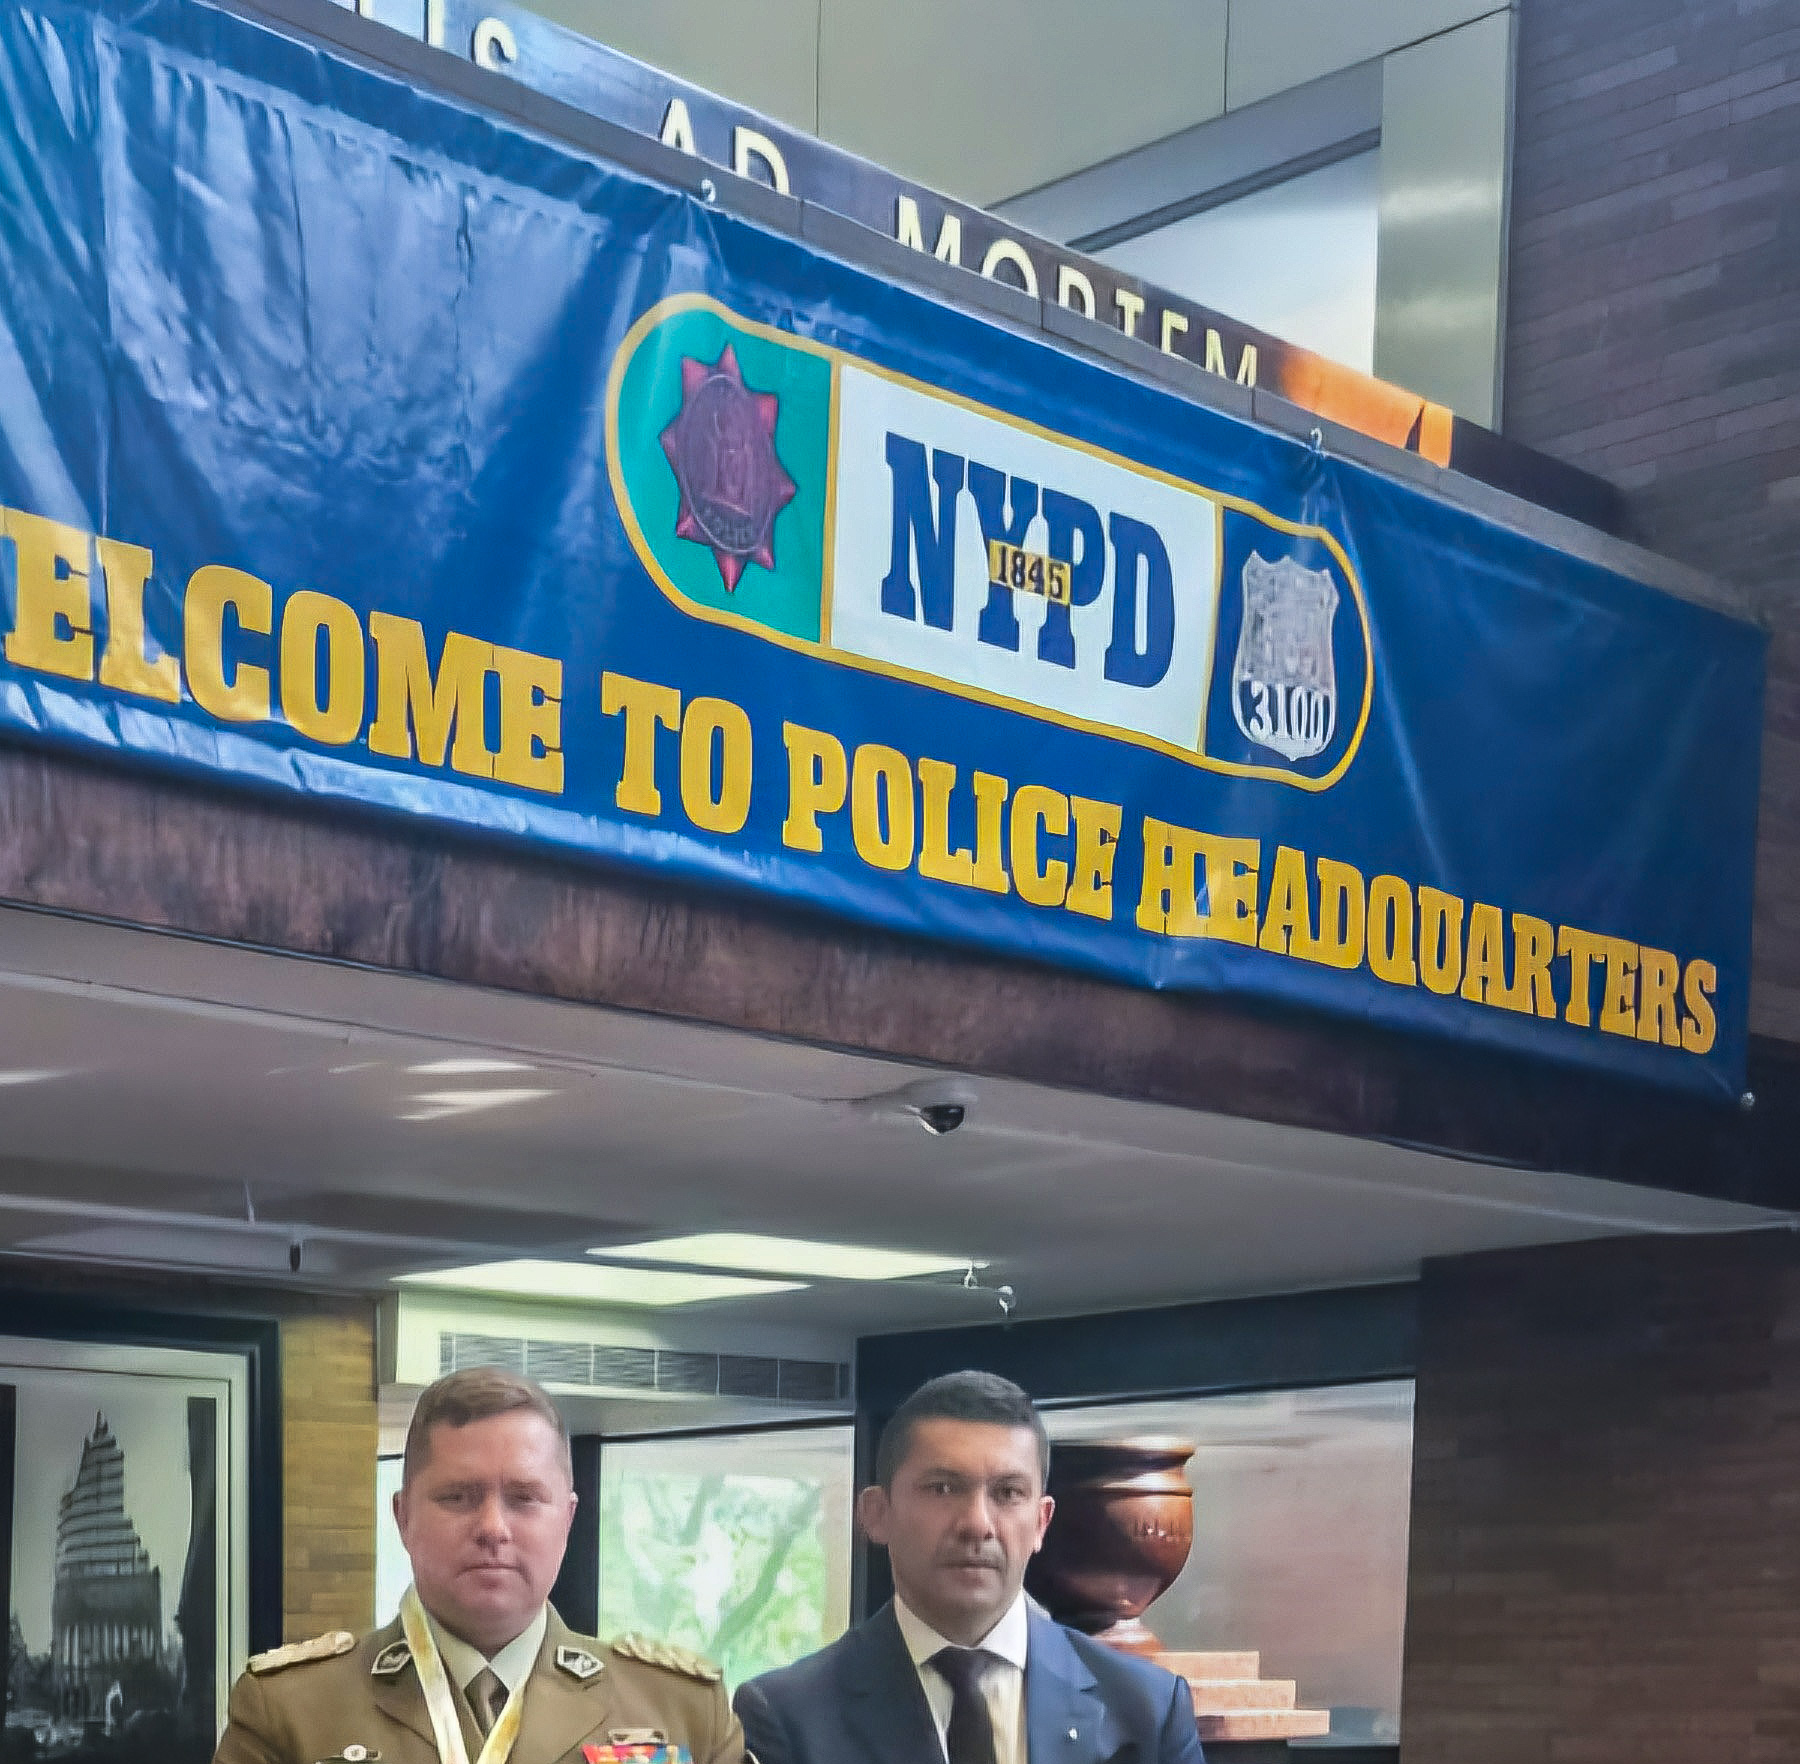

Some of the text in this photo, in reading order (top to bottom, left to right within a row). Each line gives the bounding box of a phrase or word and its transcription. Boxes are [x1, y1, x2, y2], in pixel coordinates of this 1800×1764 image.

[881, 431, 1175, 689] NYPD
[997, 545, 1065, 600] 1845
[1249, 680, 1326, 742] 3100
[602, 670, 753, 834] TO
[782, 721, 1122, 921] POLICE
[1136, 815, 1718, 1055] HEADQUARTERS
